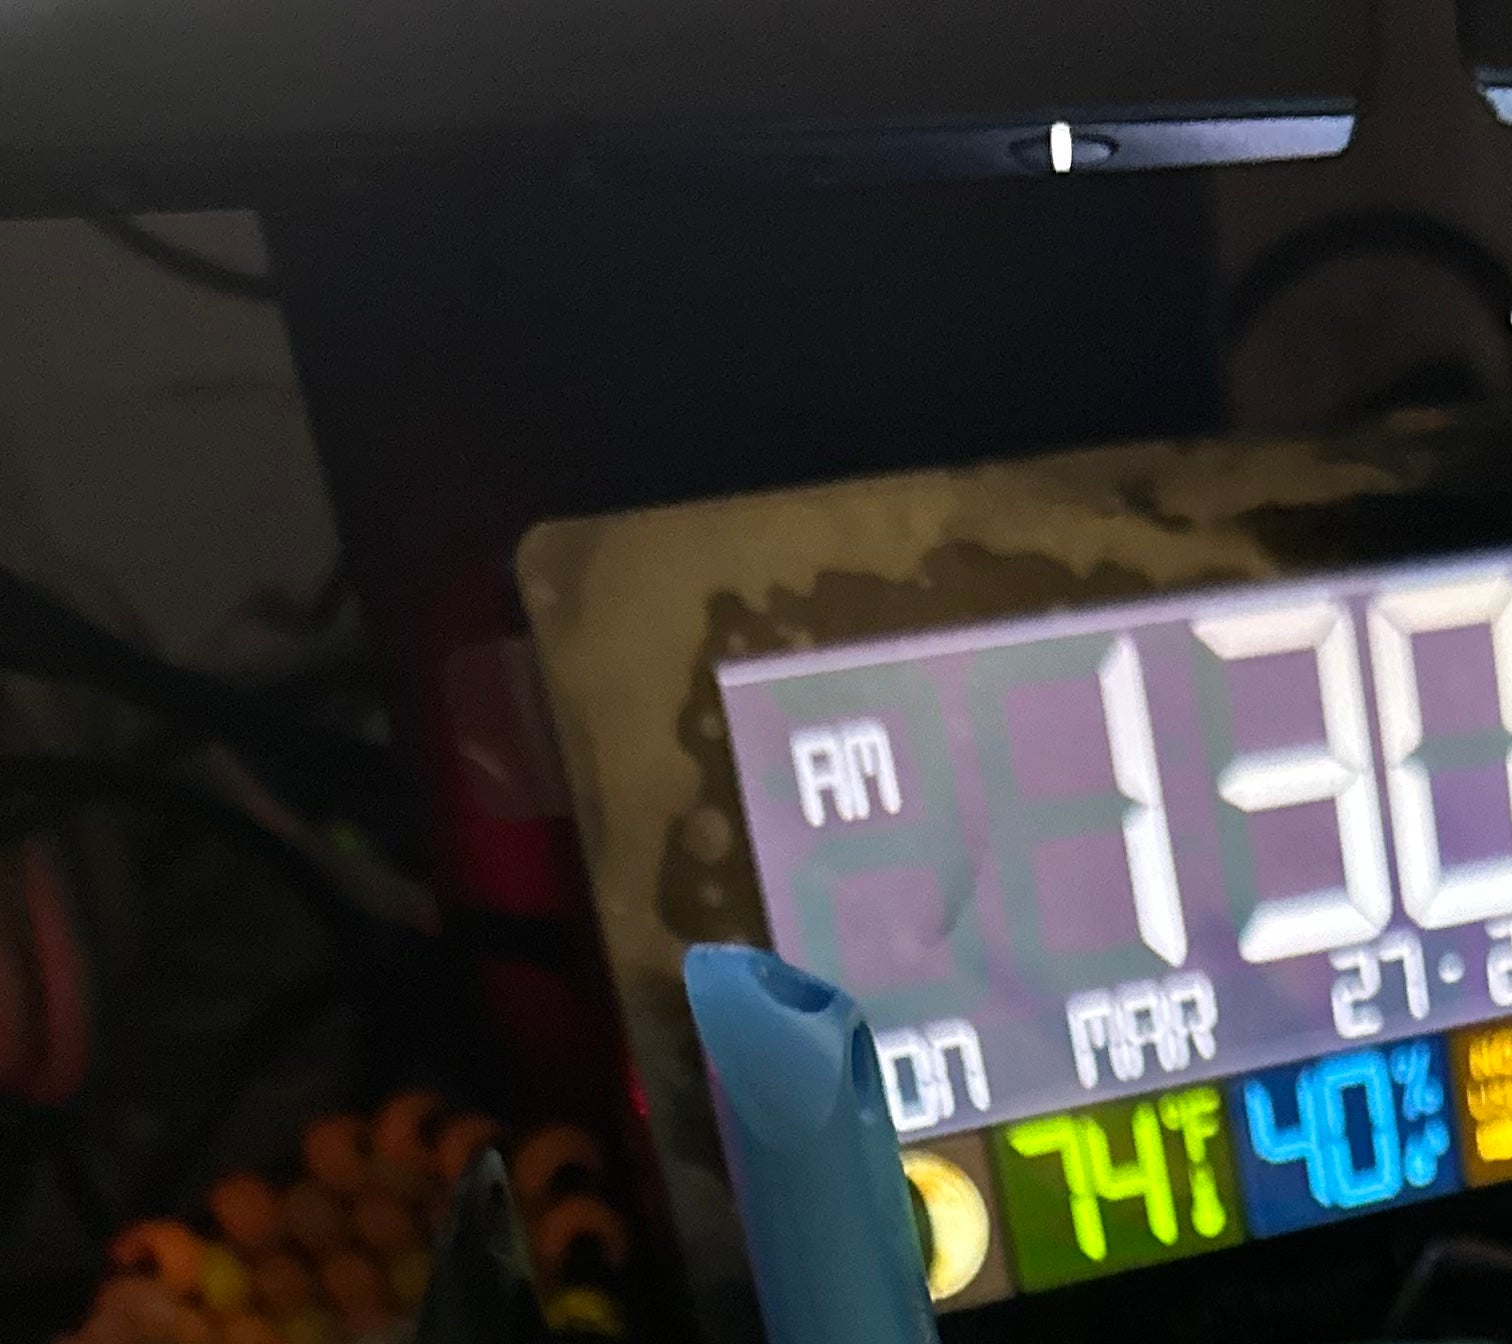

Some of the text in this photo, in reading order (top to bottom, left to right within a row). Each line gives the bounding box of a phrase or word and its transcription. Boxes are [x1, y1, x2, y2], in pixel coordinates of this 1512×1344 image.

[788, 719, 900, 827] AM
[874, 1018, 990, 1133] ON
[1067, 973, 1218, 1090] MAR
